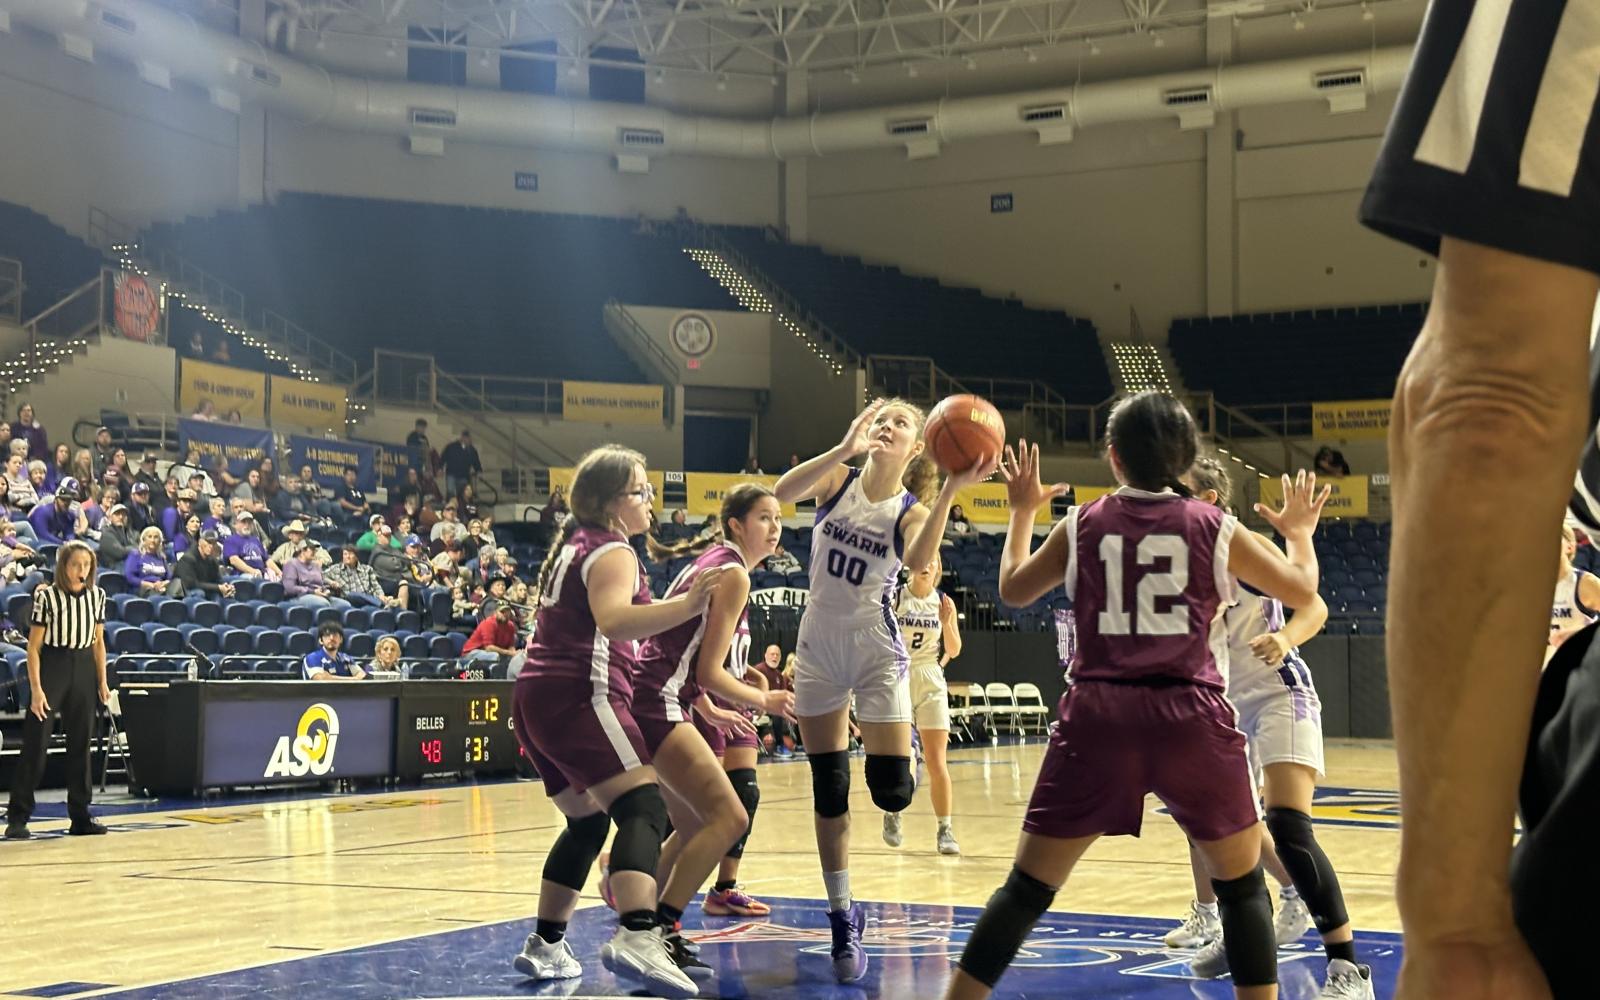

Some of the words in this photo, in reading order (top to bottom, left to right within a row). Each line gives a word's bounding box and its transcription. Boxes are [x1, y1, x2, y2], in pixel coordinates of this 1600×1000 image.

[582, 397, 618, 408] AMERICAN
[620, 399, 660, 409] CHEVROLET
[667, 473, 682, 482] 105
[704, 490, 717, 500] JIM
[973, 498, 1001, 508] FRANKE
[822, 521, 889, 559] SWARM
[827, 548, 867, 586] 00
[1098, 534, 1189, 634] 12
[898, 617, 939, 629] SWARM
[911, 632, 924, 649] 2
[465, 670, 484, 680] POSS
[471, 698, 499, 721] 1:12
[416, 716, 445, 730] BELLES
[264, 732, 339, 778] ASU
[421, 740, 442, 763] 48
[473, 737, 482, 761] 3
